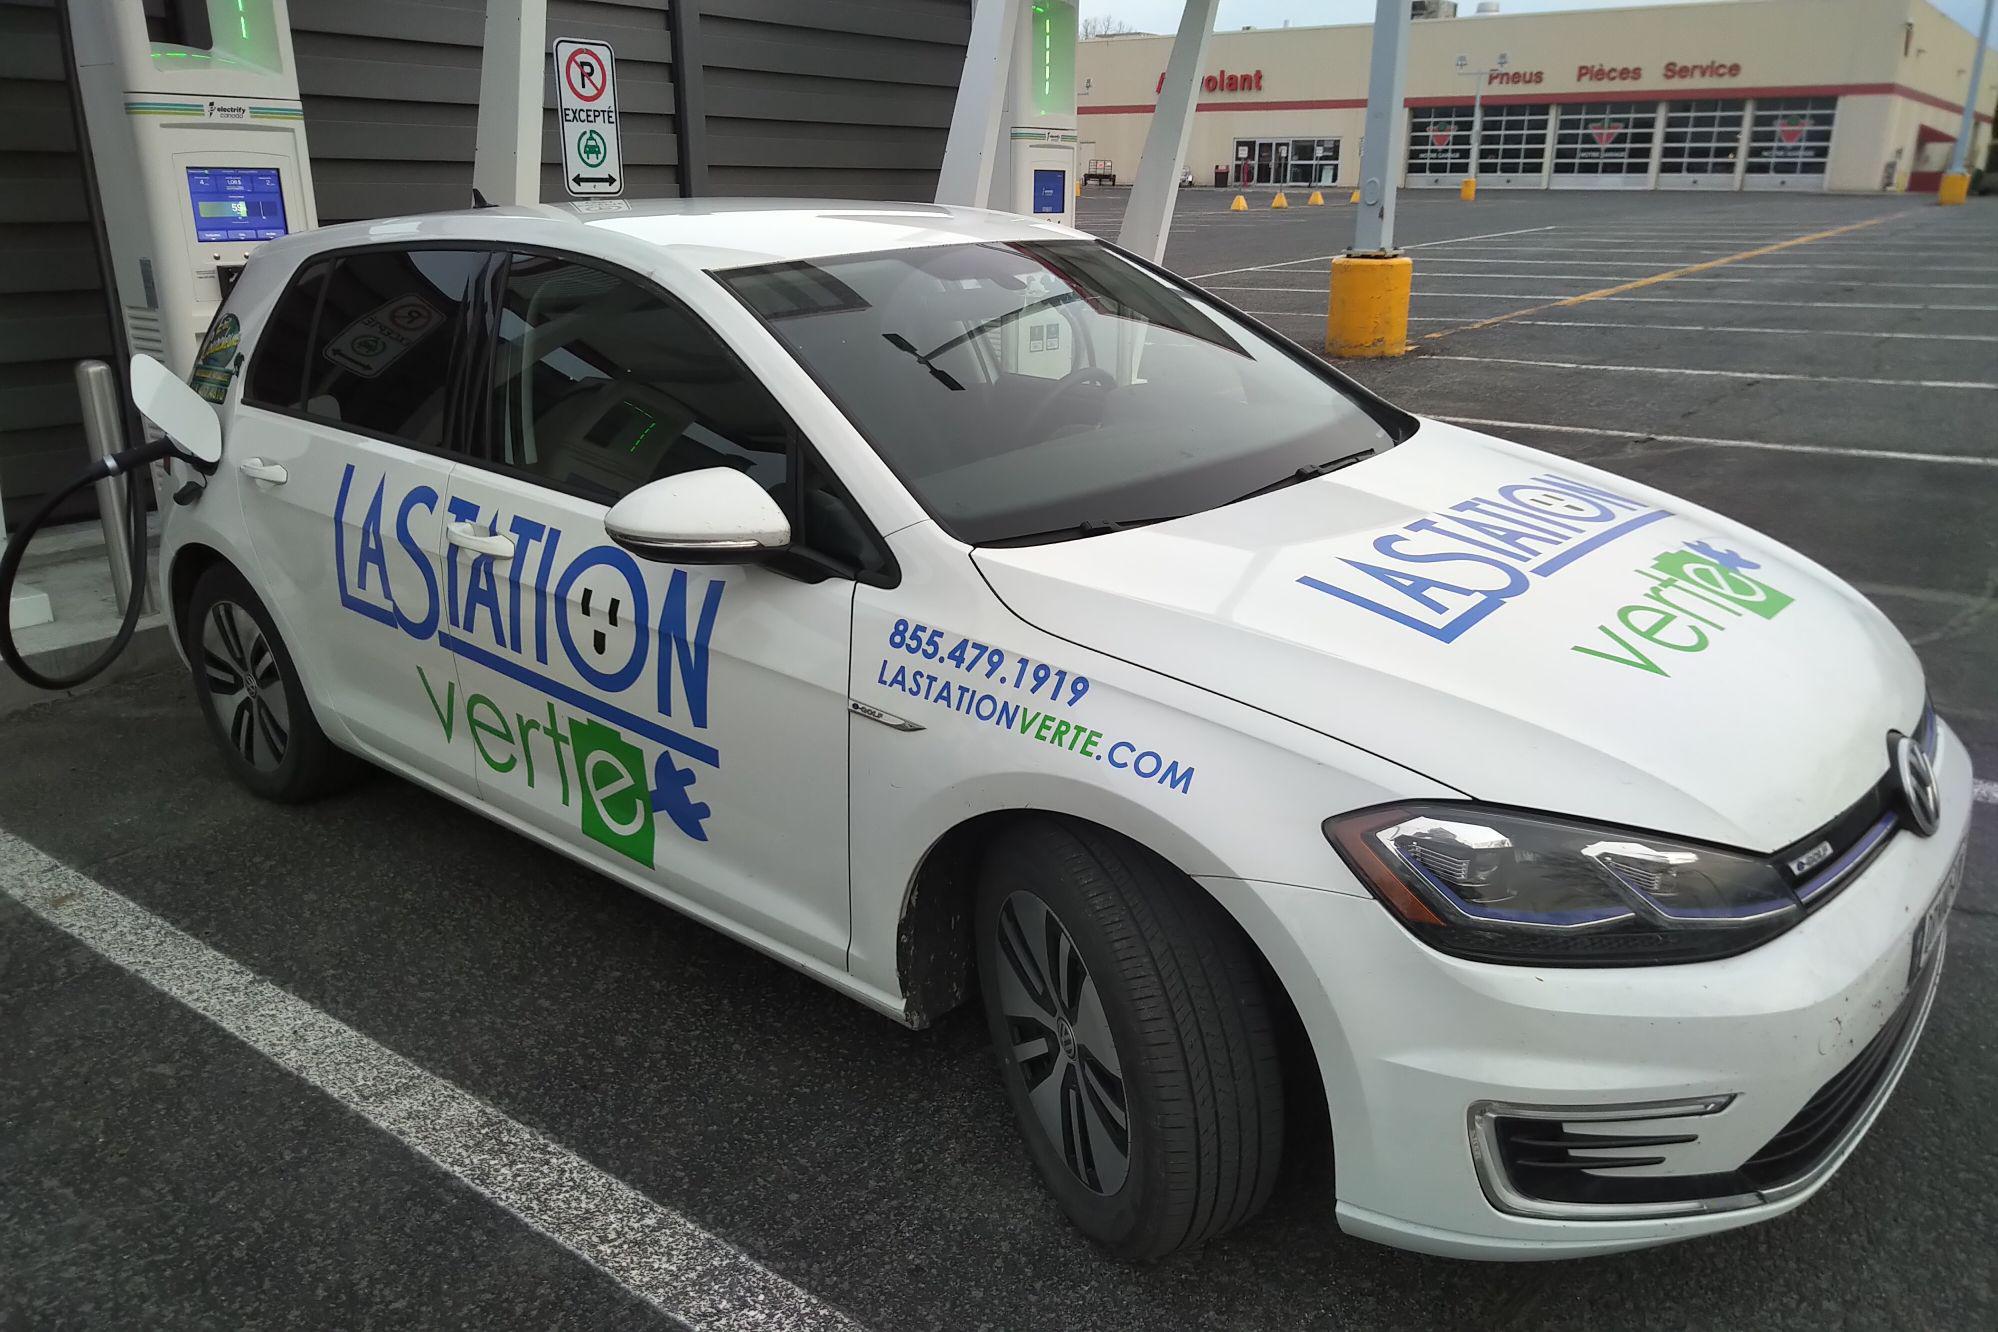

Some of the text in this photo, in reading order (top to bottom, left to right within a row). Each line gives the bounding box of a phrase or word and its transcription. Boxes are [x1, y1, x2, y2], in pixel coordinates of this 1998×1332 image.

[1200, 69, 1262, 93] olant
[1488, 68, 1544, 86] Pneus
[1662, 60, 1741, 80] Service
[217, 105, 246, 115] electrify
[563, 106, 615, 125] EXCEPTÉ
[889, 618, 1090, 708] 855.479.1919
[877, 659, 1196, 795] LASTATIONVERTE.COM
